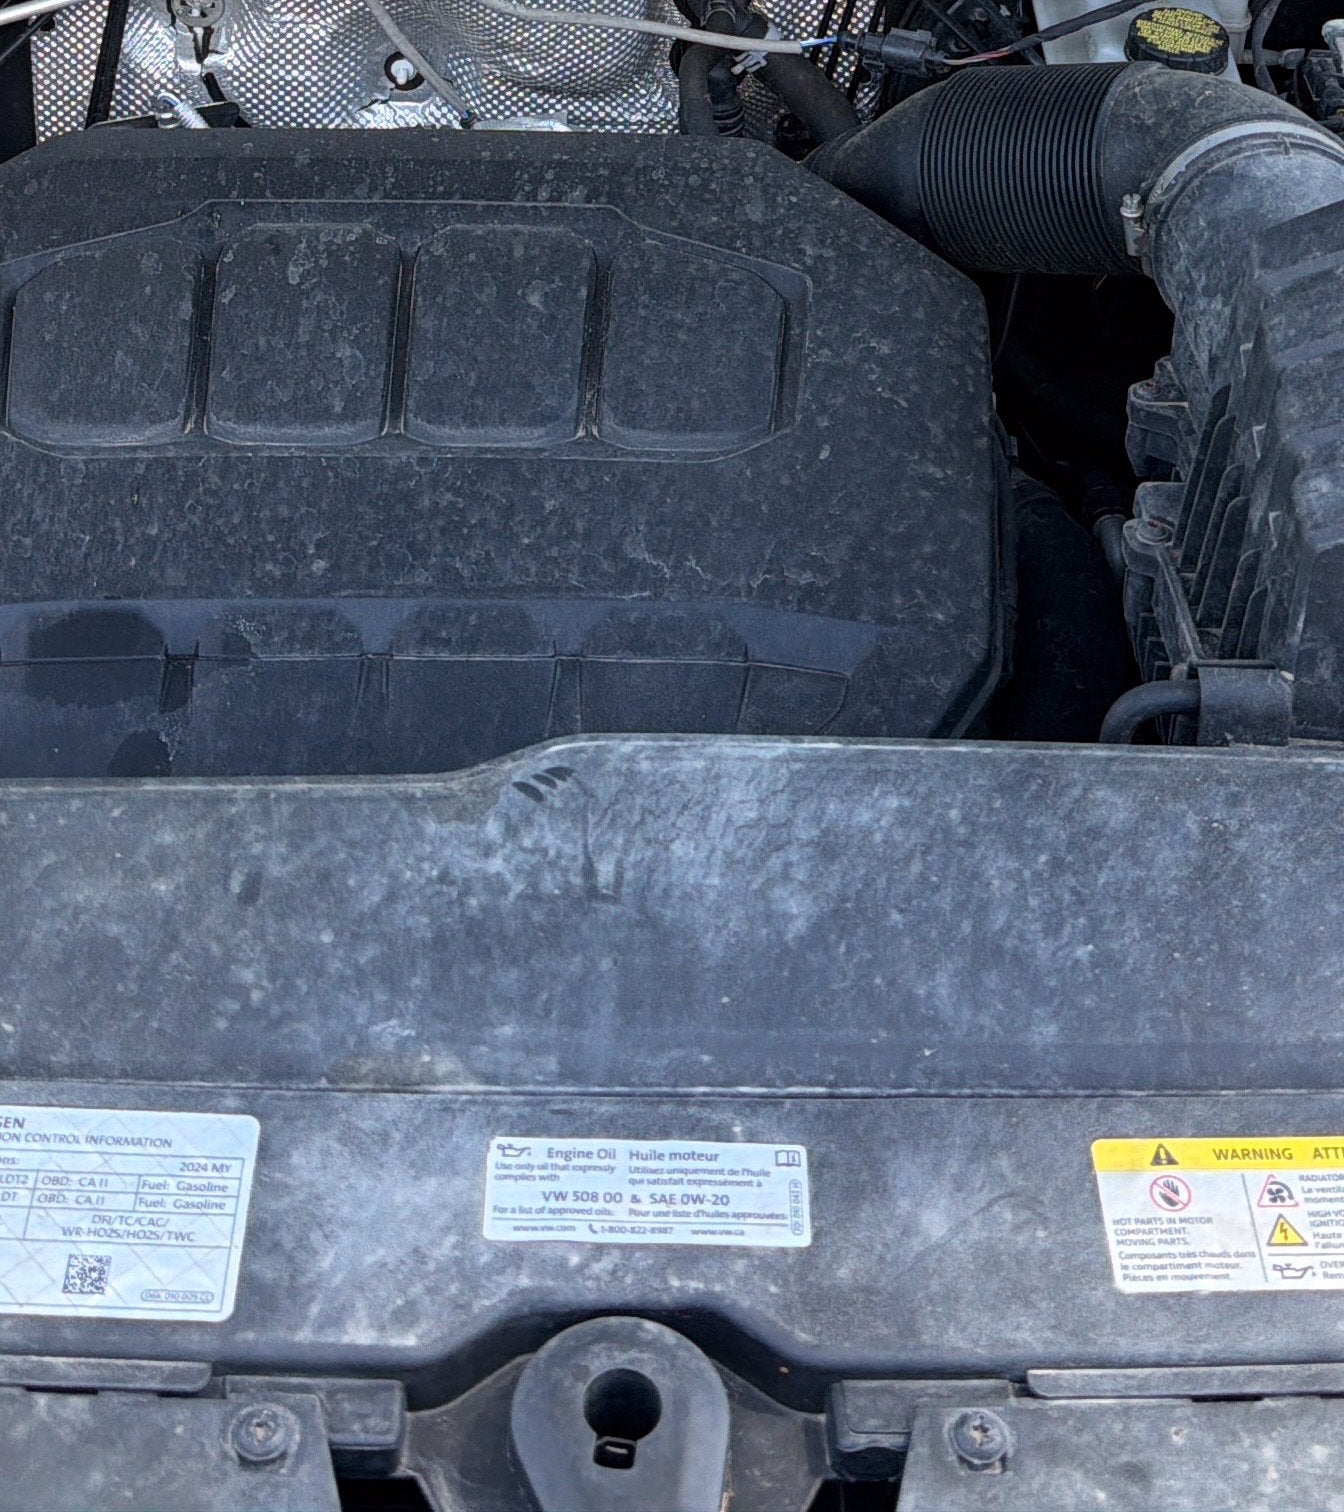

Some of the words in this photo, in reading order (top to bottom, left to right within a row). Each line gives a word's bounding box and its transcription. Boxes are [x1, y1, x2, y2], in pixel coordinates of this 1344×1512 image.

[24, 1132, 81, 1144] CONTROL
[84, 1134, 173, 1148] INFORMATION
[546, 1147, 594, 1162] Engine
[596, 1148, 617, 1160] Oil
[629, 1149, 665, 1161] Huile
[668, 1150, 720, 1162] moteur
[1211, 1147, 1294, 1161] WARNING
[179, 1161, 209, 1173] 2024
[211, 1162, 233, 1174] MY
[494, 1161, 514, 1171] Use
[514, 1161, 535, 1173] only
[536, 1162, 549, 1171] oil
[550, 1162, 570, 1171] that
[571, 1163, 616, 1175] expressly
[628, 1165, 664, 1175] Utilisez
[666, 1166, 725, 1178] uniquement
[727, 1167, 740, 1176] de
[741, 1167, 771, 1177] l'huile
[41, 1175, 72, 1186] OBD:
[78, 1176, 97, 1188] CA
[494, 1173, 537, 1184] complies
[538, 1173, 561, 1183] with
[628, 1177, 644, 1187] qui
[646, 1177, 684, 1187] satisfait
[141, 1179, 170, 1191] Fuel:
[176, 1179, 229, 1193] Gasoline
[1301, 1185, 1313, 1194] Le
[37, 1192, 69, 1204] OBD:
[74, 1194, 93, 1206] CA
[138, 1196, 168, 1209] Fuel:
[172, 1197, 227, 1211] Gasoline
[541, 1190, 569, 1202] VW
[572, 1190, 599, 1203] 508
[602, 1191, 624, 1204] 00
[629, 1193, 642, 1204] &
[649, 1193, 677, 1205] SAE
[680, 1193, 731, 1206] 0W-20
[492, 1205, 509, 1214] For
[510, 1206, 516, 1214] a
[518, 1205, 533, 1215] list
[534, 1205, 546, 1215] of
[546, 1206, 593, 1217] approved
[628, 1207, 651, 1217] Pour
[652, 1208, 670, 1217] une
[671, 1208, 692, 1218] liste
[1307, 1209, 1333, 1218] HIGH
[1112, 1217, 1133, 1226] HOT
[1133, 1216, 1164, 1226] PARTS
[1166, 1216, 1177, 1225] IN
[1178, 1215, 1214, 1225] MOTOR
[1116, 1237, 1156, 1247] MOVING
[1312, 1231, 1343, 1240] Haute
[1118, 1250, 1178, 1262] Composants
[1232, 1249, 1256, 1259] dans
[1120, 1261, 1131, 1271] le
[1131, 1260, 1203, 1273] compartiment
[1155, 1273, 1169, 1282] en
